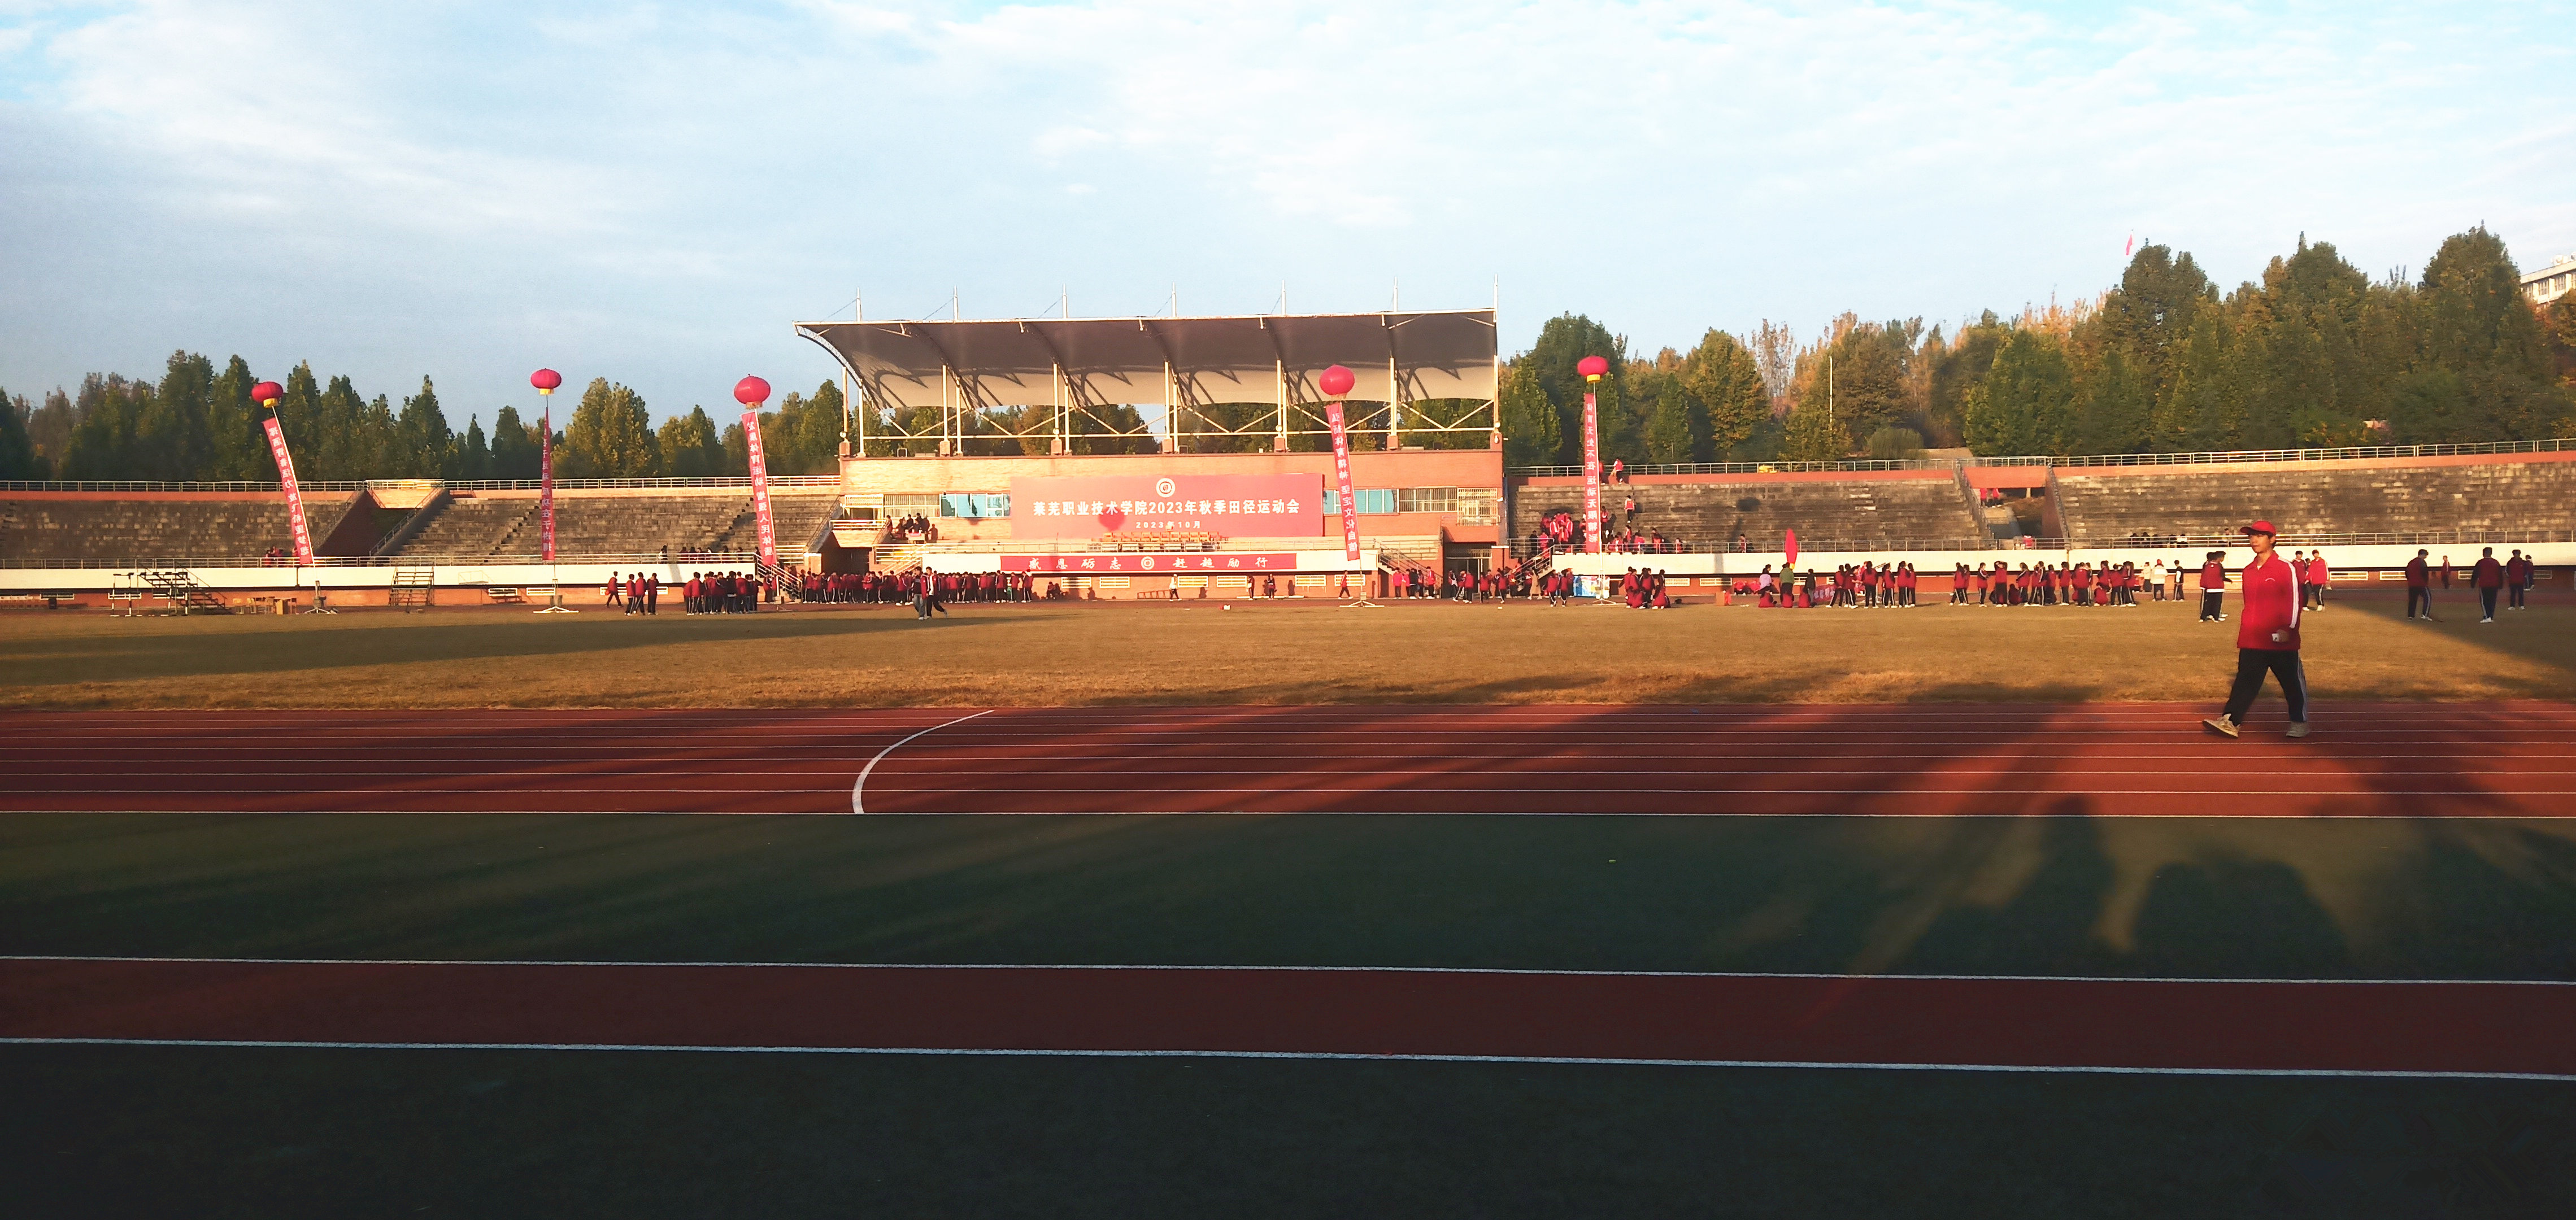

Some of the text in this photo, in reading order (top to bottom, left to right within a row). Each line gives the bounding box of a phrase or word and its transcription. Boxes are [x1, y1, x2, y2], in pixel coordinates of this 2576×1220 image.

[1033, 500, 1300, 516] 莱芜职业技术学院2023年秋季田径运动会
[1029, 556, 1268, 570] 感恩砺志 赶超励行
